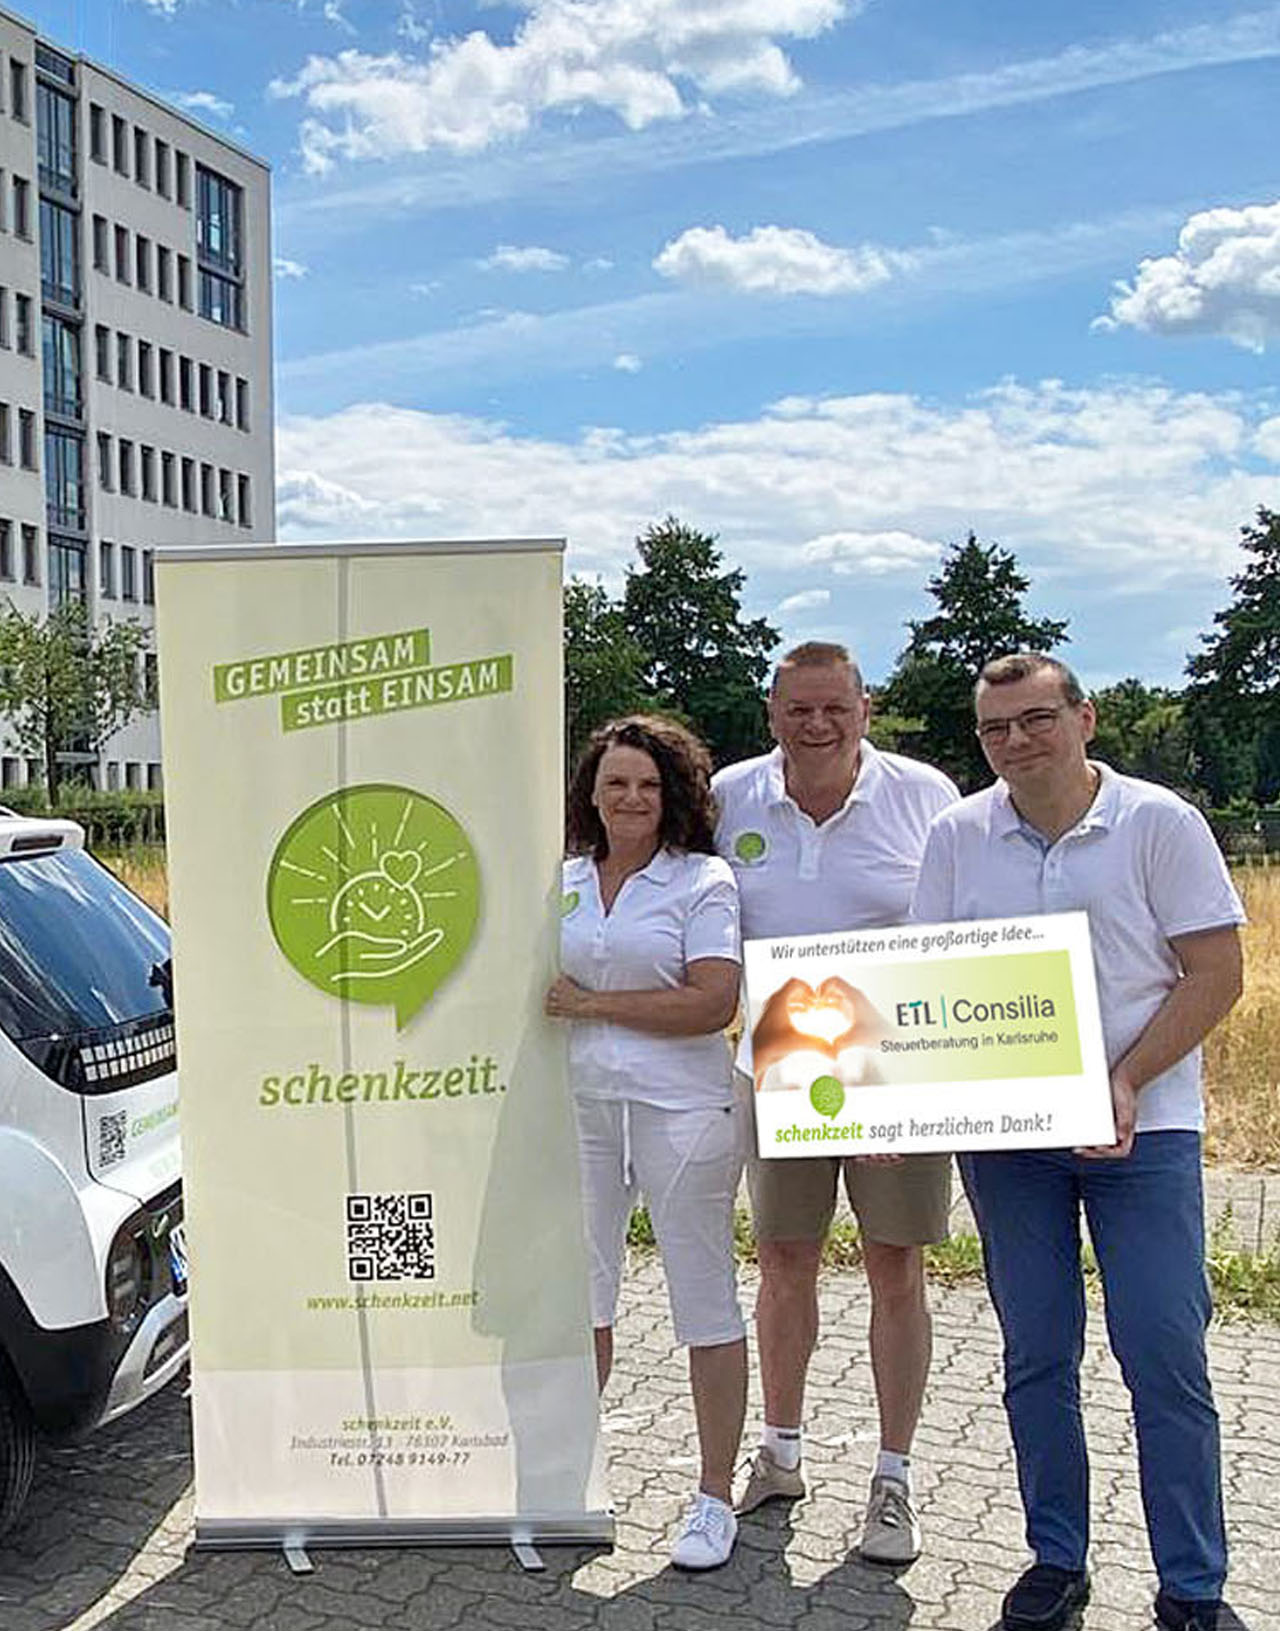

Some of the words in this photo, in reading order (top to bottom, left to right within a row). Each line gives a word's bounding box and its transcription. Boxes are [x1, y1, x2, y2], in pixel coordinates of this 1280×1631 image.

[226, 636, 415, 695] GEMEINSAM
[296, 686, 371, 726] statt
[382, 662, 499, 709] EINSAM
[771, 945, 795, 959] Wir
[798, 939, 885, 957] unterstützen
[889, 934, 918, 950] eine
[921, 928, 999, 952] großartige
[1001, 926, 1045, 941] Idee...
[896, 1000, 936, 1026] ETL
[953, 995, 1056, 1023] Consilia
[881, 1036, 979, 1053] Steuerberatung
[982, 1033, 994, 1046] in
[996, 1030, 1059, 1045] Karlsruhe
[260, 1054, 507, 1106] schenkzeit.
[775, 1122, 864, 1143] schenkzeit
[869, 1122, 903, 1143] sagt
[909, 1117, 993, 1137] herzlichen
[1000, 1114, 1053, 1134] Dank!
[307, 1290, 479, 1310] www.schenkzeit.net
[342, 1416, 421, 1431] schenkzeit
[425, 1415, 454, 1430] e.V.
[330, 1452, 354, 1466] Tel.
